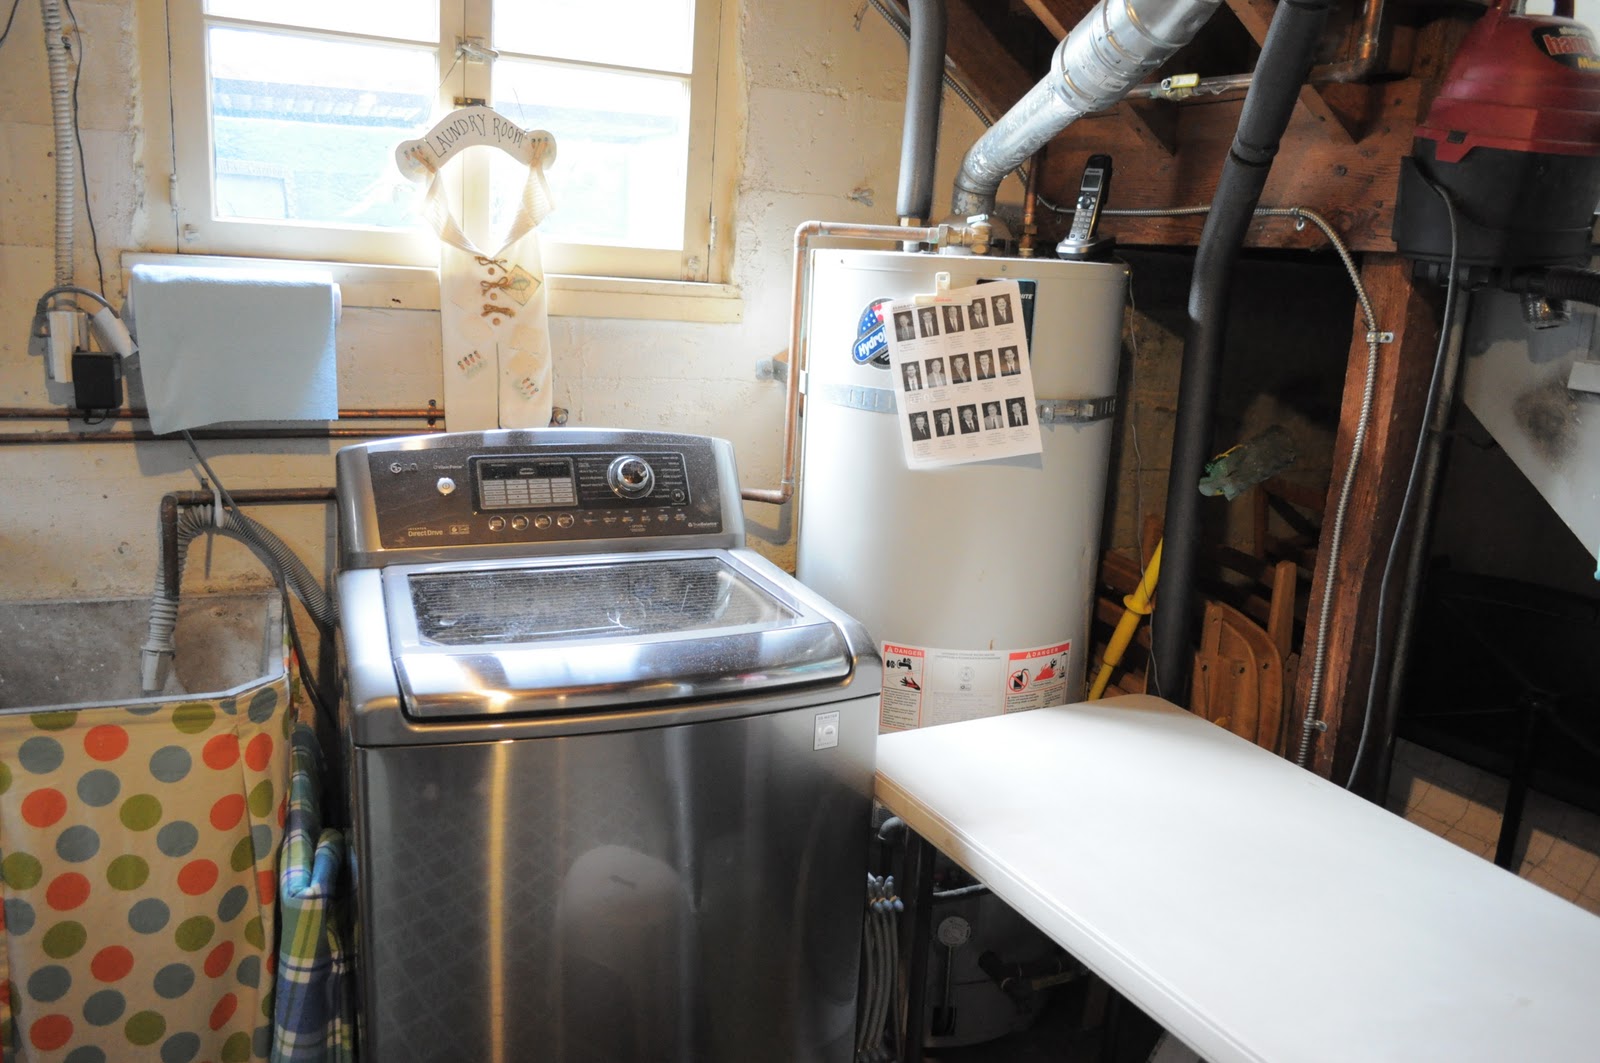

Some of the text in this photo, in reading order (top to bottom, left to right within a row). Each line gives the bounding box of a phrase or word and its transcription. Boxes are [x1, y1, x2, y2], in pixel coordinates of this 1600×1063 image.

[427, 114, 487, 158] LAUNDRY
[894, 648, 922, 657] DANGER
[1032, 647, 1059, 657] DANGER
